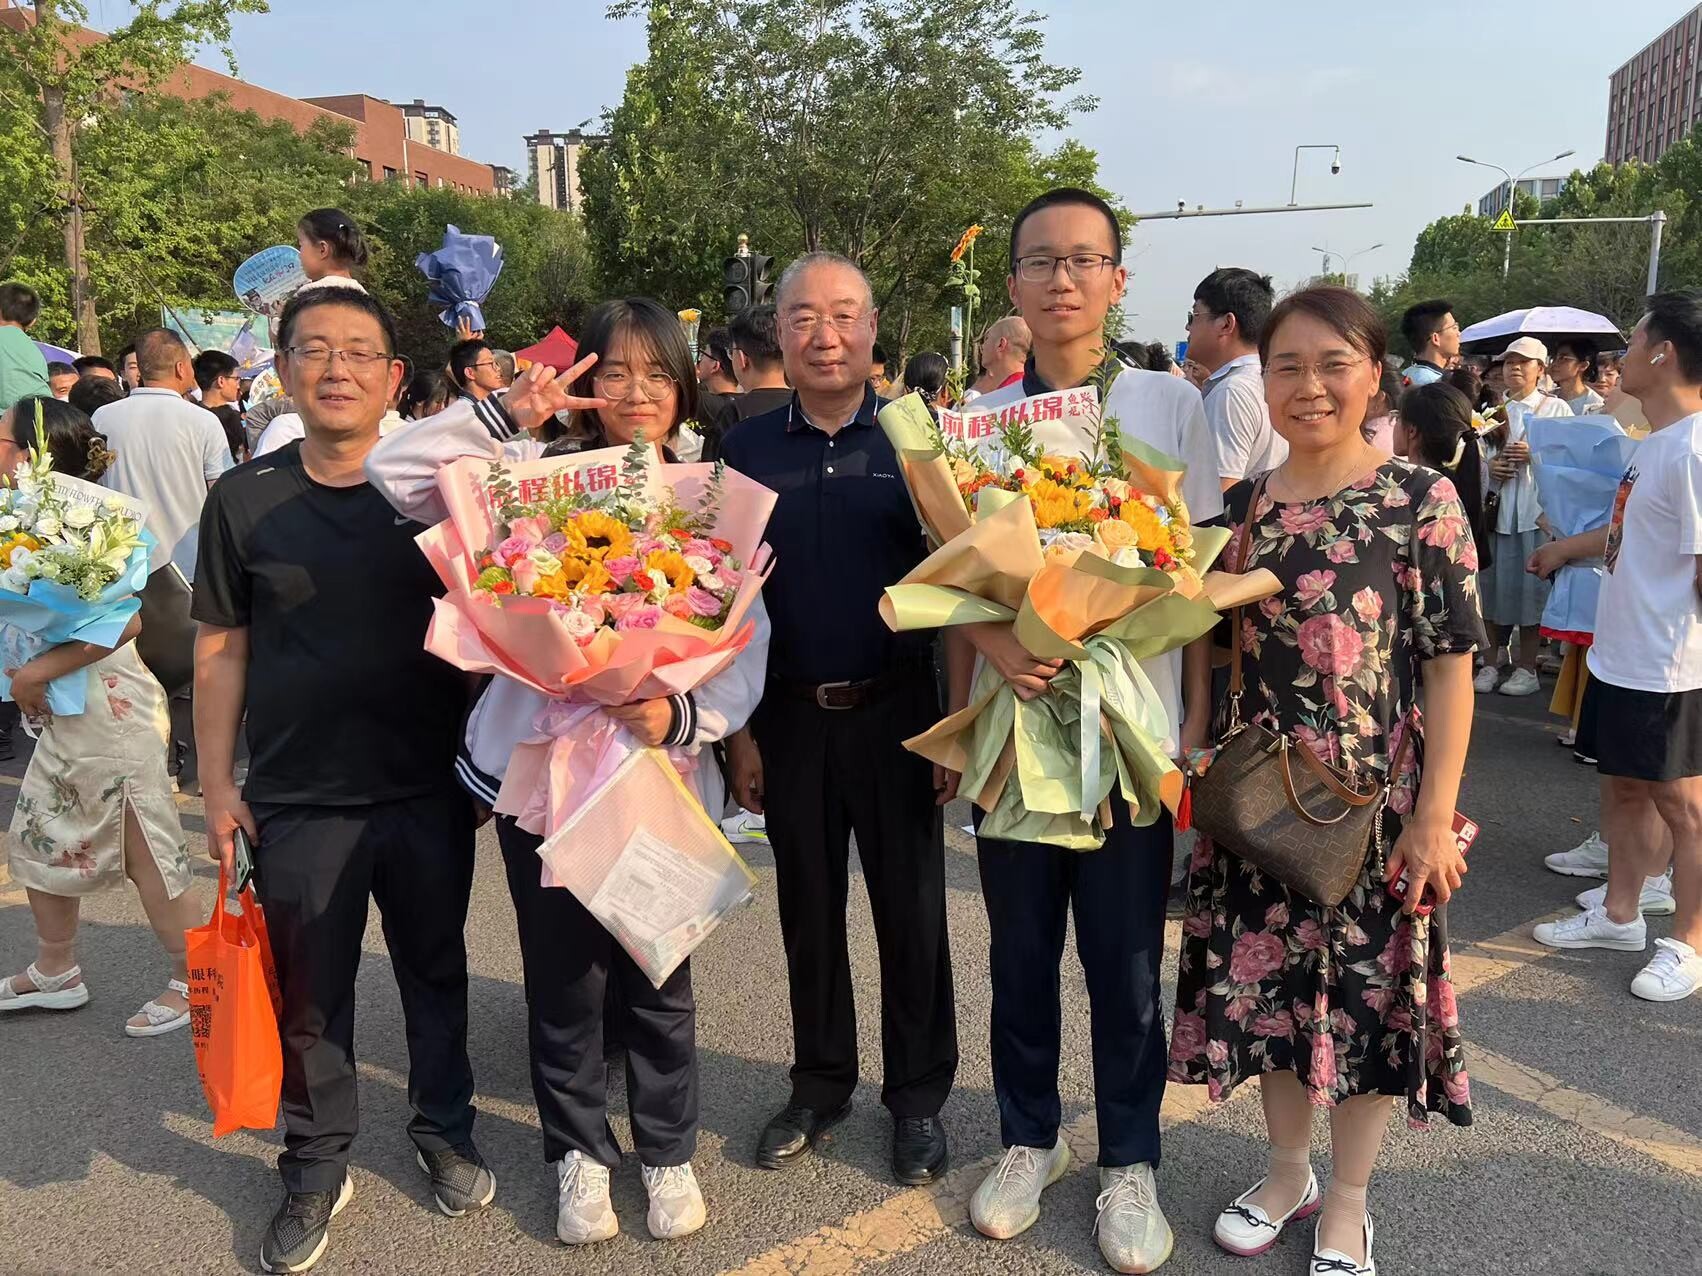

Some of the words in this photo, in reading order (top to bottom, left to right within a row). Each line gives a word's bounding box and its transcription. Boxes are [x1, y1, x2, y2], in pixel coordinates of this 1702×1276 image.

[942, 396, 1063, 440] 前程似锦
[187, 967, 217, 981] 眼科
